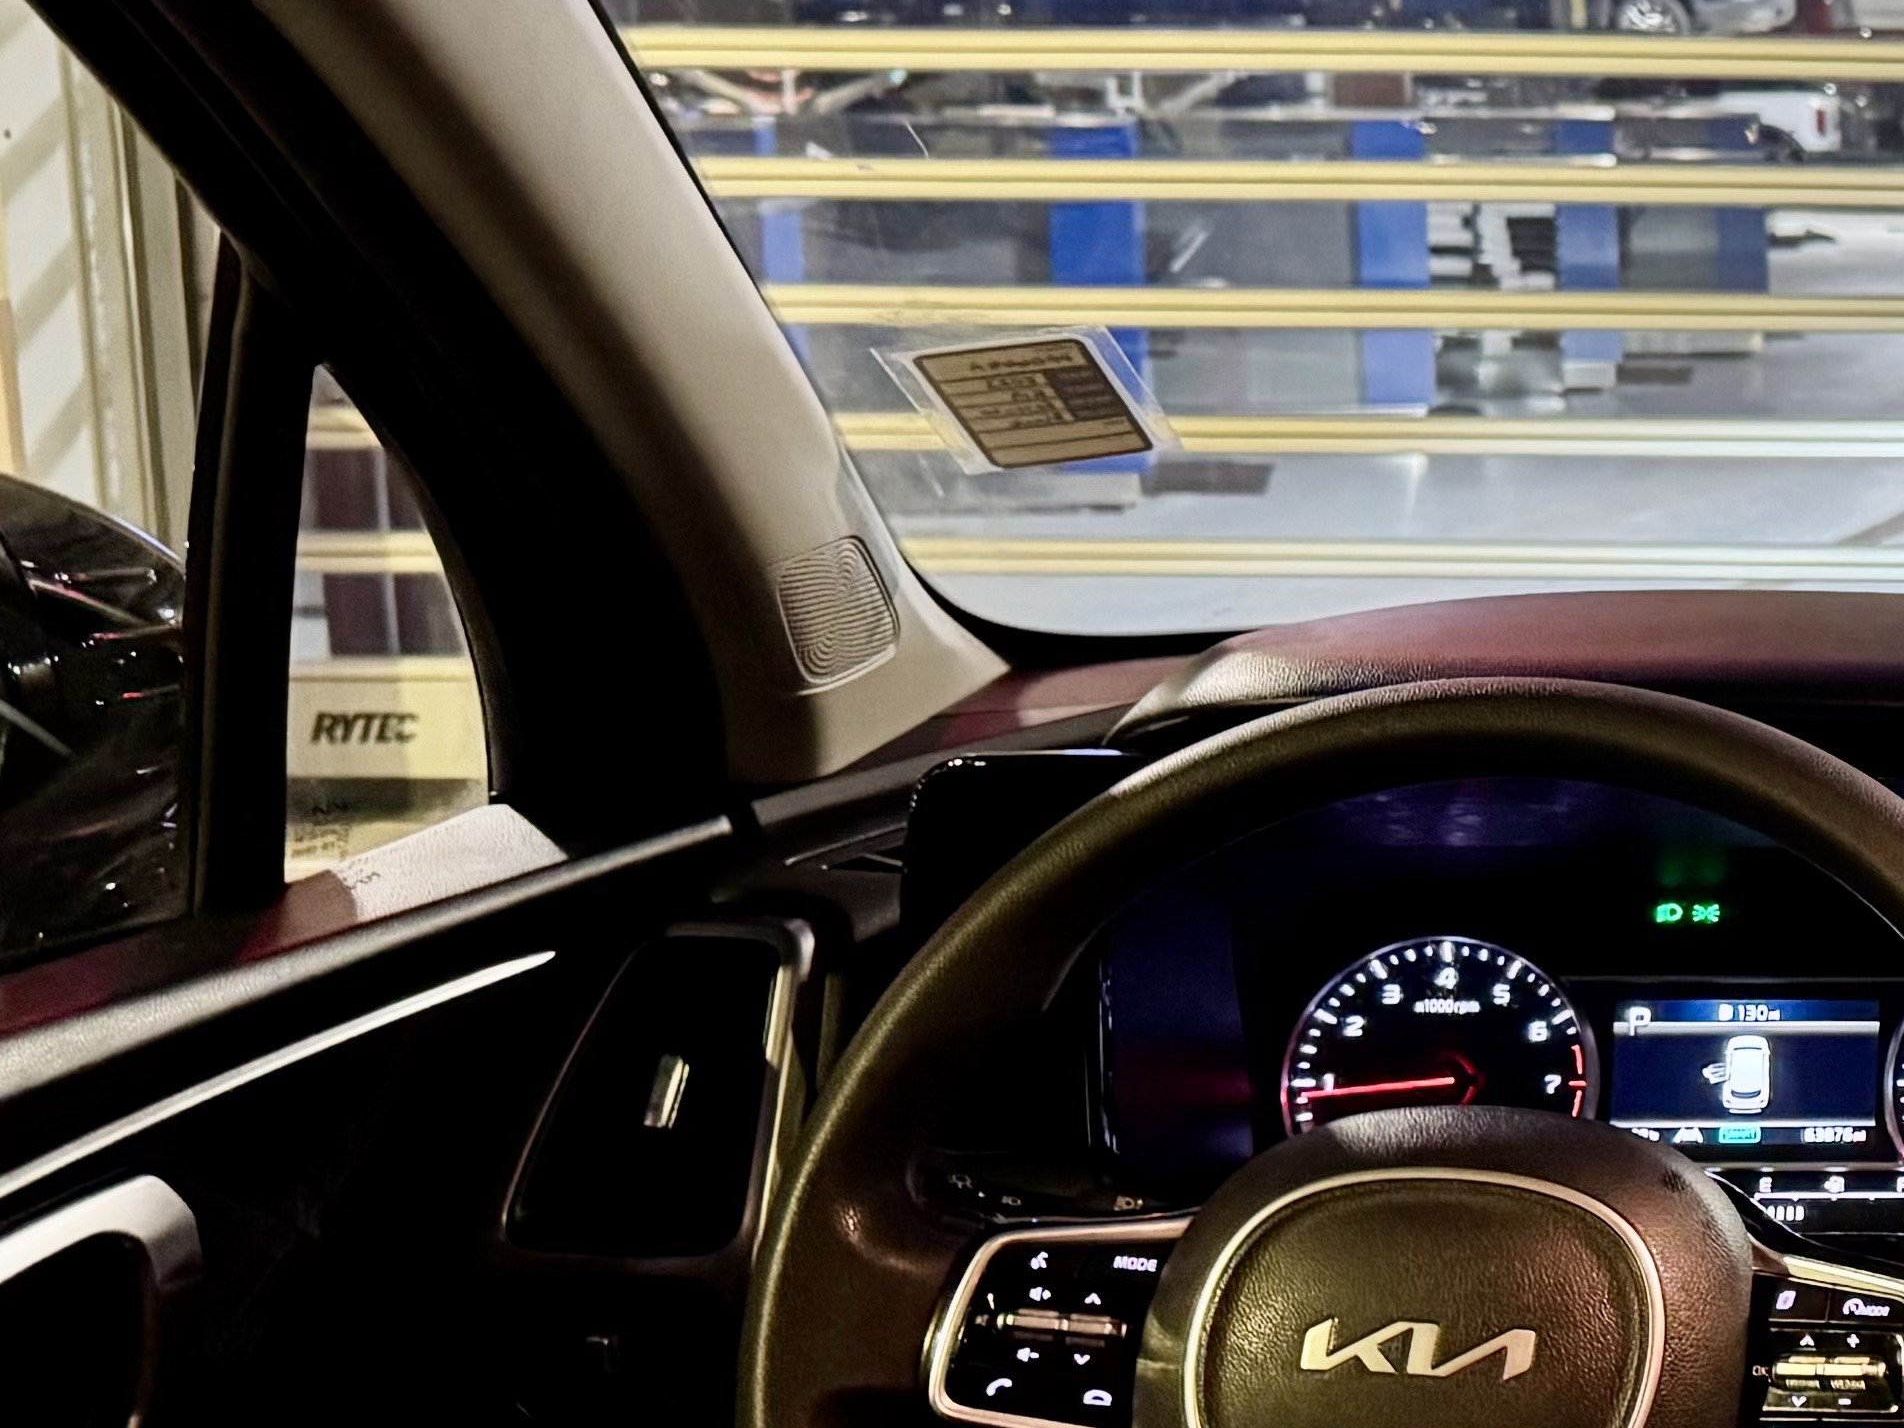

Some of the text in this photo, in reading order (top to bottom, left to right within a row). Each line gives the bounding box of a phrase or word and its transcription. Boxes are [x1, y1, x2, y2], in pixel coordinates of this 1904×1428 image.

[310, 712, 419, 745] RYTEC
[1435, 968, 1459, 990] 4
[1382, 984, 1403, 1004] 3
[1493, 984, 1511, 1004] 5
[1343, 1016, 1365, 1037] 2
[1627, 1006, 1652, 1036] P
[1528, 1022, 1548, 1042] 6
[1322, 1073, 1335, 1091] 1
[1544, 1074, 1562, 1094] 7
[1759, 1177, 1773, 1193] E
[1113, 1255, 1158, 1272] MODE
[1300, 1317, 1536, 1380] KIA
